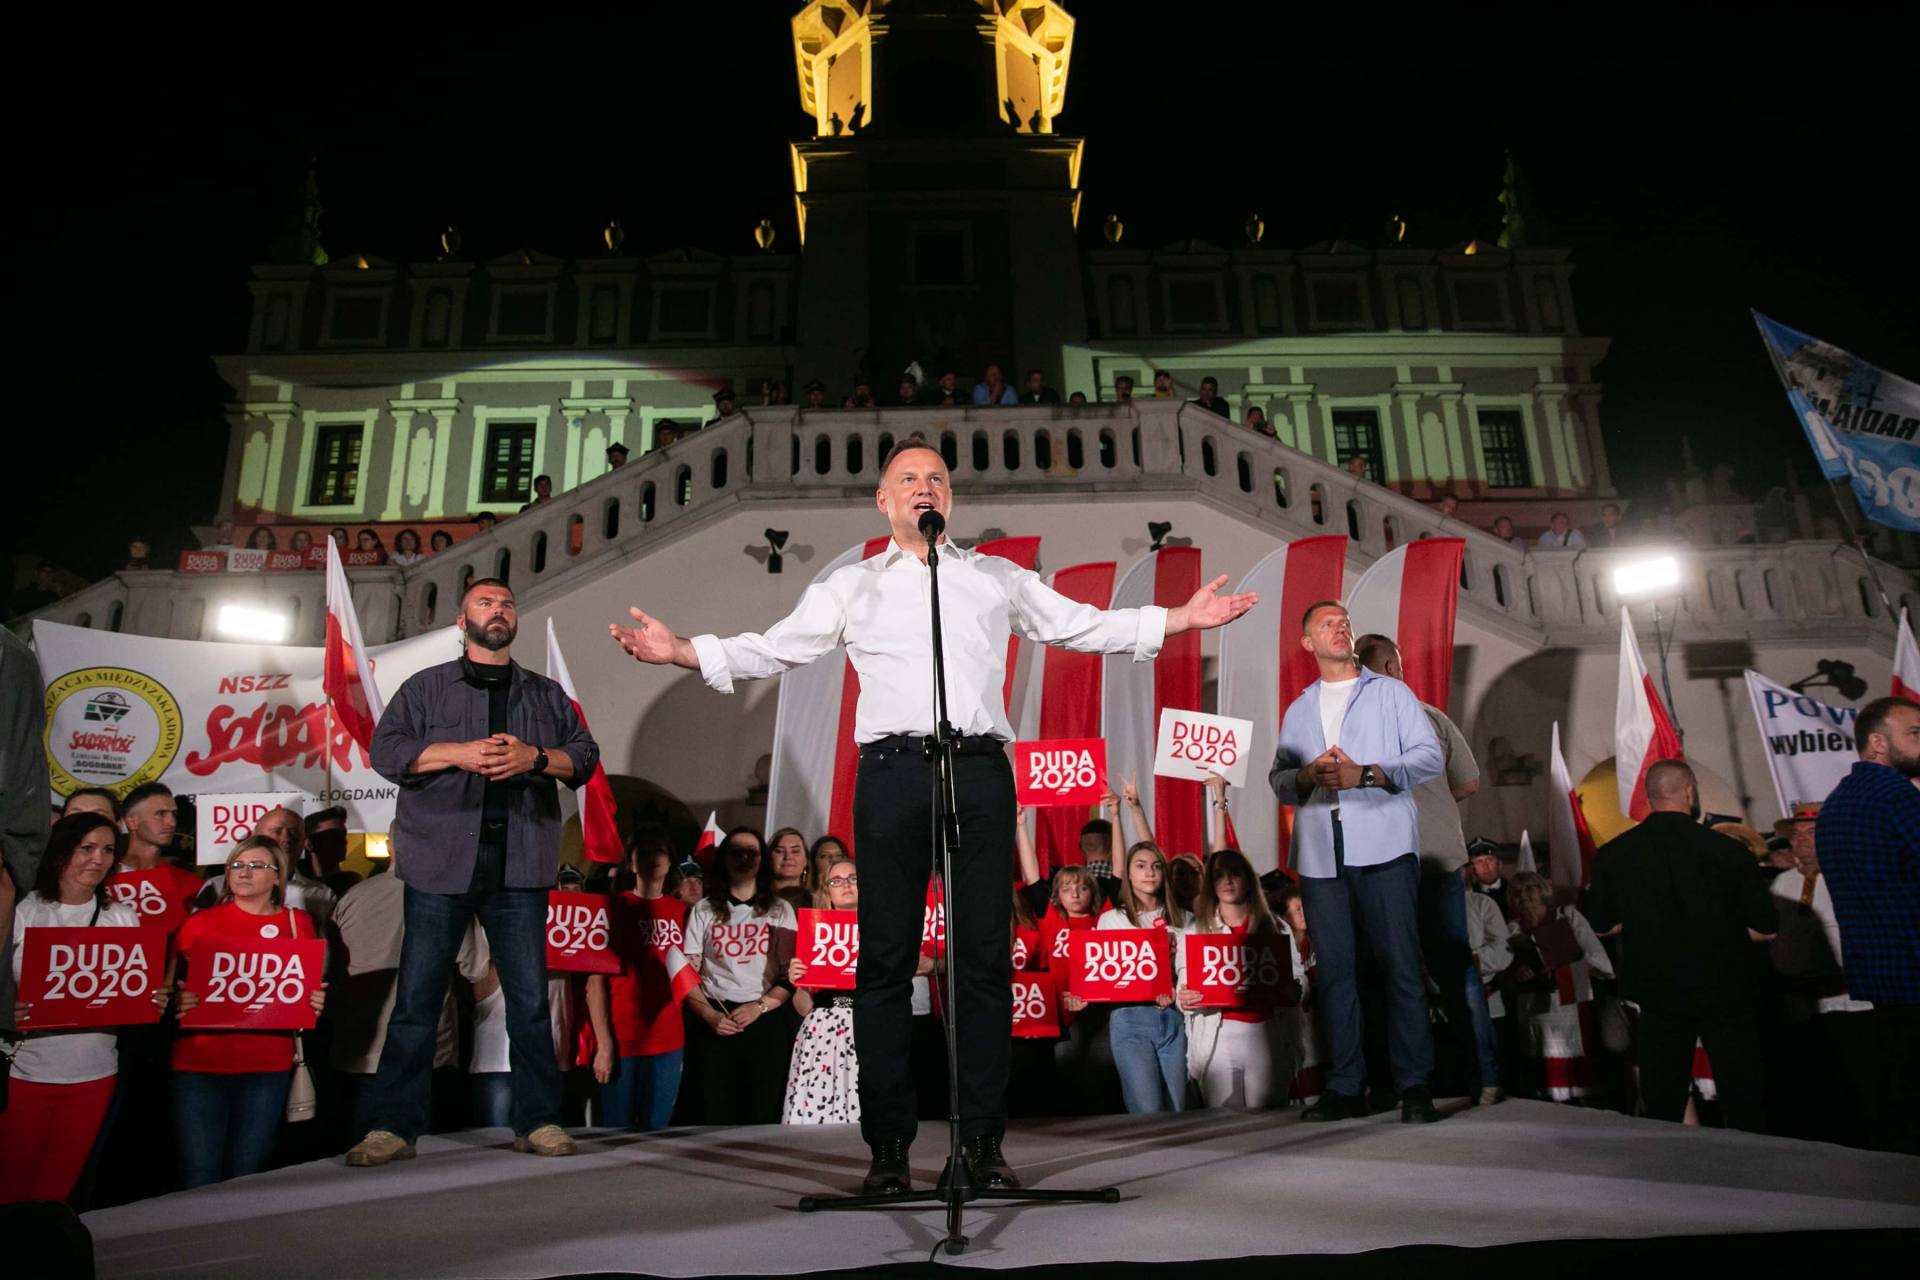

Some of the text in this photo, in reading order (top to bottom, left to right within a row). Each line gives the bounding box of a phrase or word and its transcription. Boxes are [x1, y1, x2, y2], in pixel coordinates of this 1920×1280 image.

[186, 562, 218, 571] 2020
[188, 554, 218, 563] DUDA
[234, 553, 264, 562] DUDA
[273, 554, 301, 562] DUDA
[350, 552, 377, 561] DUDA
[218, 674, 292, 694] NSZZ
[1172, 721, 1237, 749] DUDA
[1769, 729, 1855, 756] wybier
[1029, 750, 1095, 770] DUDA
[1170, 741, 1237, 767] 2020
[1029, 767, 1097, 790] 2020
[312, 788, 397, 802] „BOGDANK
[213, 804, 283, 825] DUD
[213, 824, 253, 845] 20
[105, 880, 162, 901] DA
[548, 926, 610, 951] 020
[711, 922, 769, 941] DUDA
[815, 922, 859, 945] DU
[50, 944, 149, 972] DUDA
[1085, 941, 1157, 962] DUDA
[1203, 945, 1279, 967] DUDA
[211, 952, 305, 980] DUDA
[1084, 959, 1158, 982] 2020
[1202, 965, 1280, 987] 2020
[43, 969, 148, 1000] 2020
[205, 977, 305, 1004] 2020
[1011, 983, 1045, 1001] DA
[1012, 1000, 1047, 1019] 20
